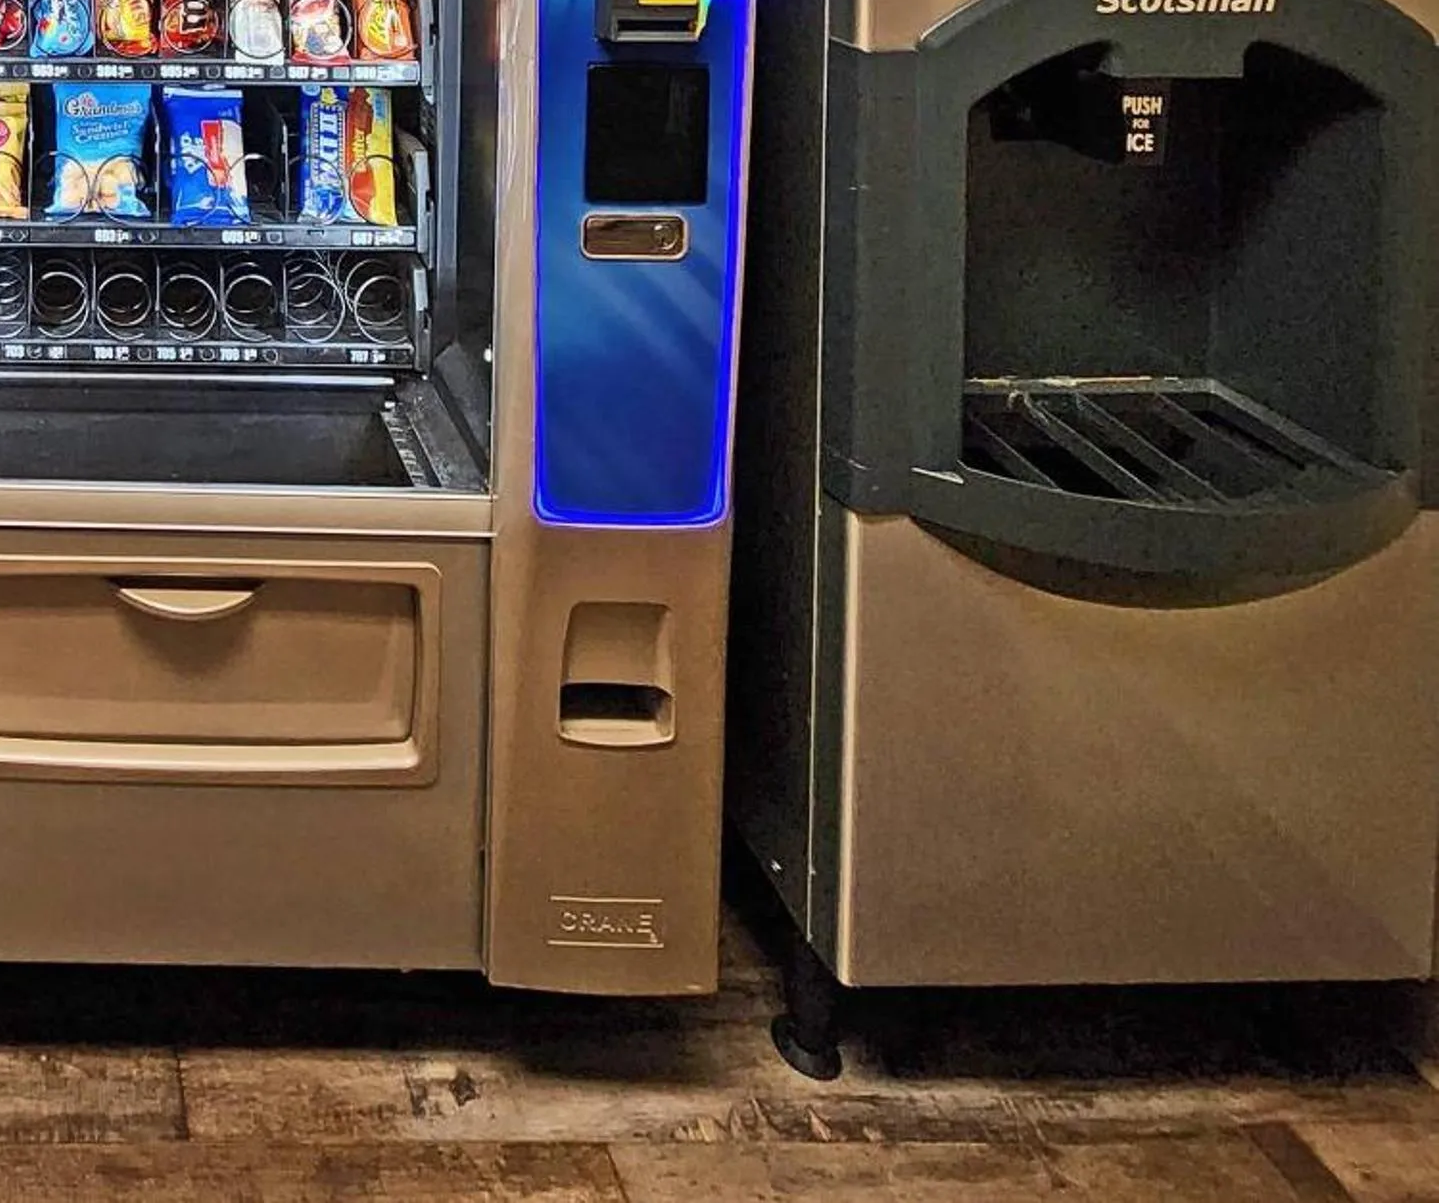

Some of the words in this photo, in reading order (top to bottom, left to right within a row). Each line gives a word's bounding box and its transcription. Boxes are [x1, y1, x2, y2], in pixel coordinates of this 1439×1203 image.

[1122, 95, 1163, 115] PUSH
[1132, 118, 1150, 129] FOR
[1126, 133, 1155, 152] ICE
[561, 911, 653, 934] CRANE
